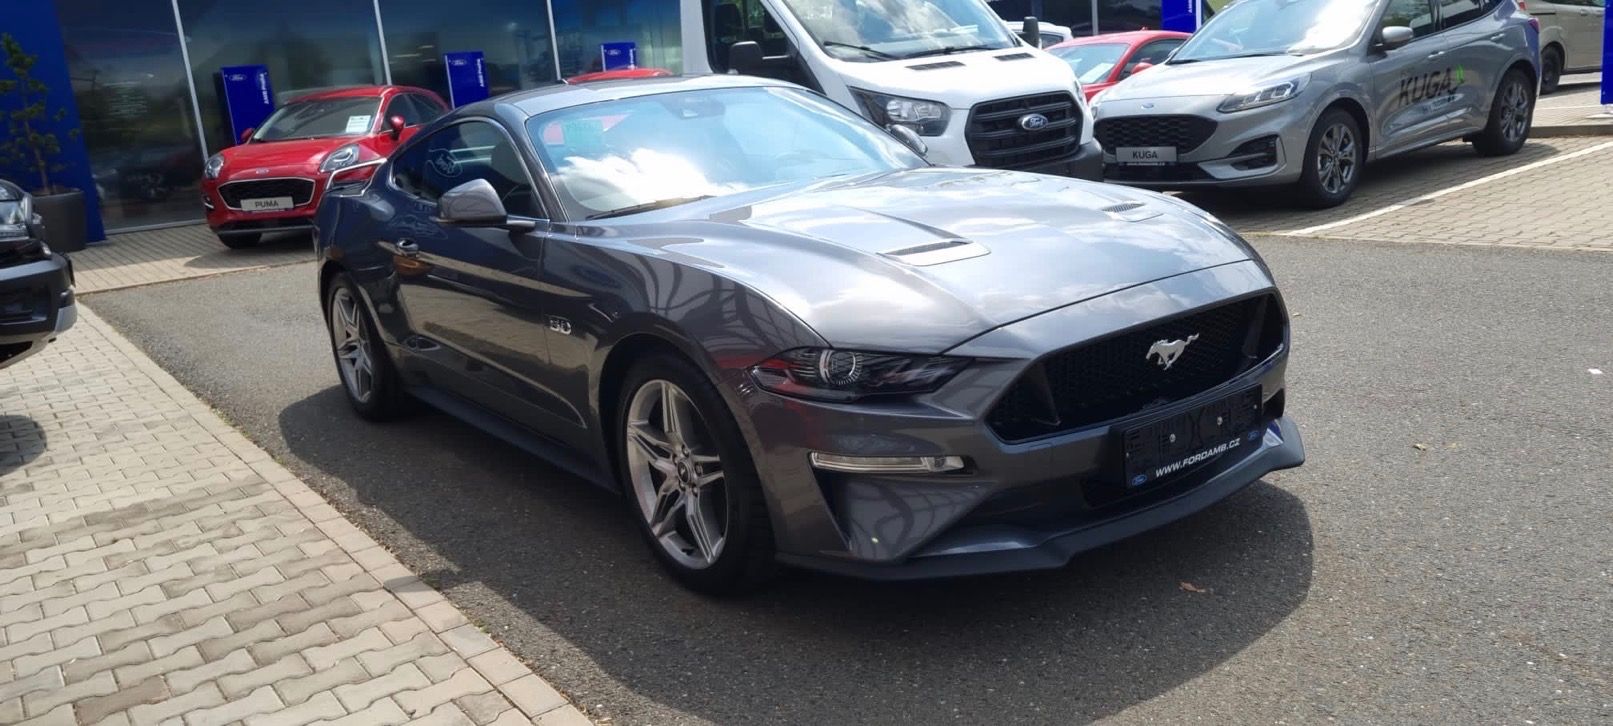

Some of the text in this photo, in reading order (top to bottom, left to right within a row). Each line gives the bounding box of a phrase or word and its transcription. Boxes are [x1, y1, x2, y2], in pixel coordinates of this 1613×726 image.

[1399, 68, 1452, 106] KUGA
[1132, 150, 1158, 159] KUGA
[255, 200, 279, 208] PUMA
[1155, 437, 1240, 478] WWW.FORDAMB.CZ
